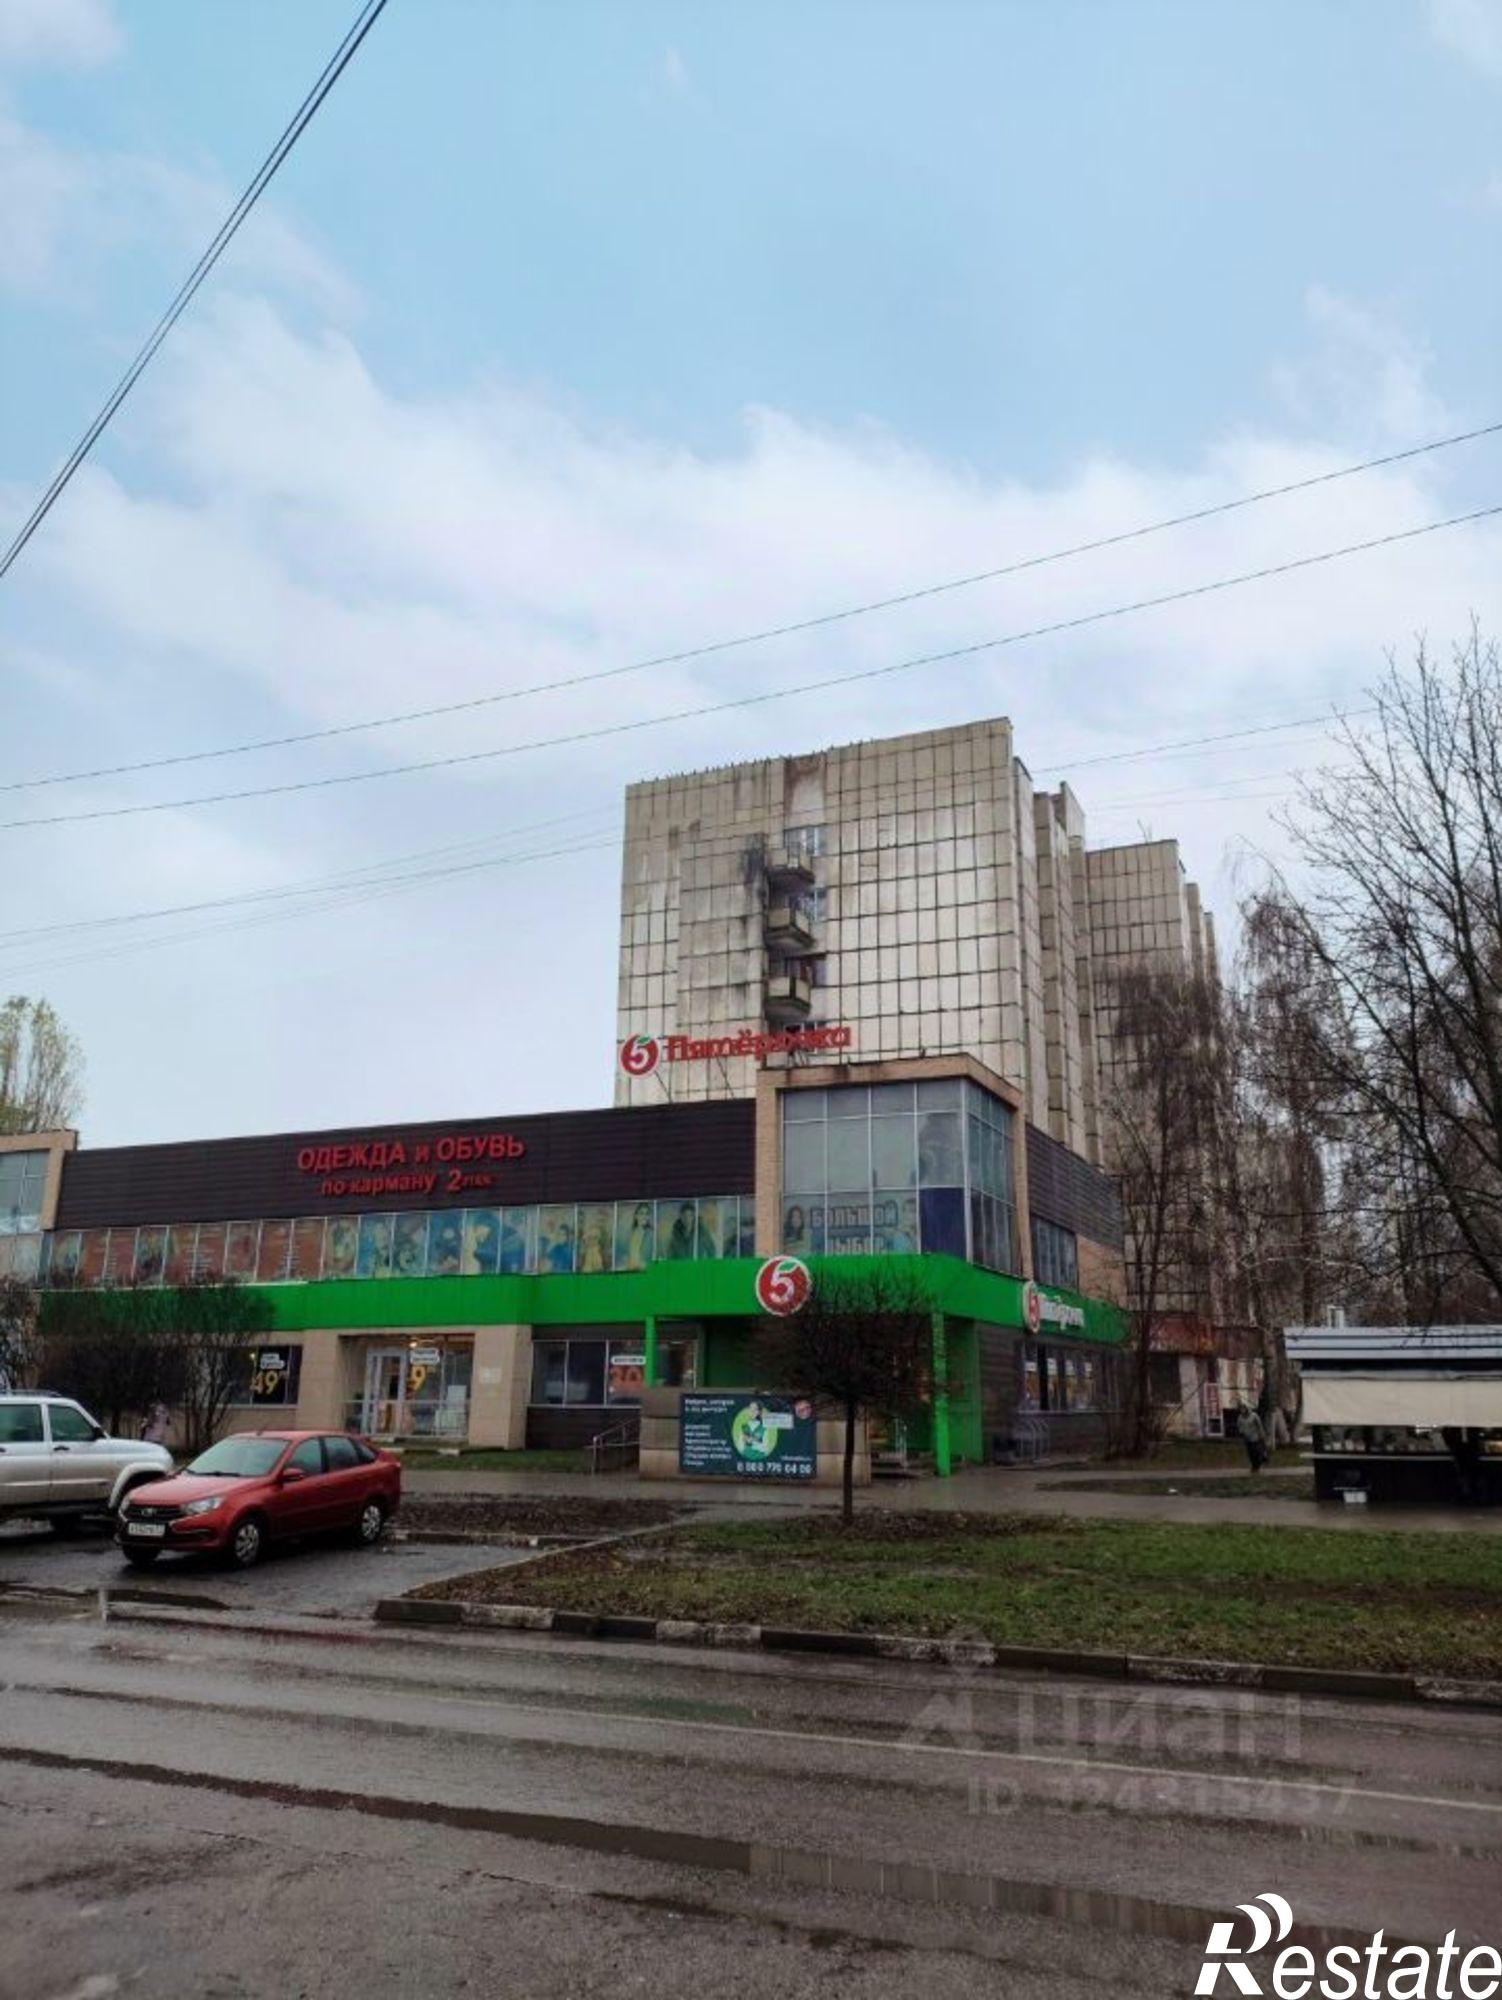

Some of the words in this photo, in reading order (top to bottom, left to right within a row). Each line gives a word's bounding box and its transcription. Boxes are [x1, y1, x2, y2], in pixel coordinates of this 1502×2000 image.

[297, 1140, 407, 1173] ОДЕЖДА
[435, 1134, 526, 1161] ОБУВЬ
[320, 1178, 346, 1195] по
[349, 1171, 437, 1197] карману
[443, 1168, 463, 1192] 2
[810, 1199, 899, 1229] БОЛЬШОЙ
